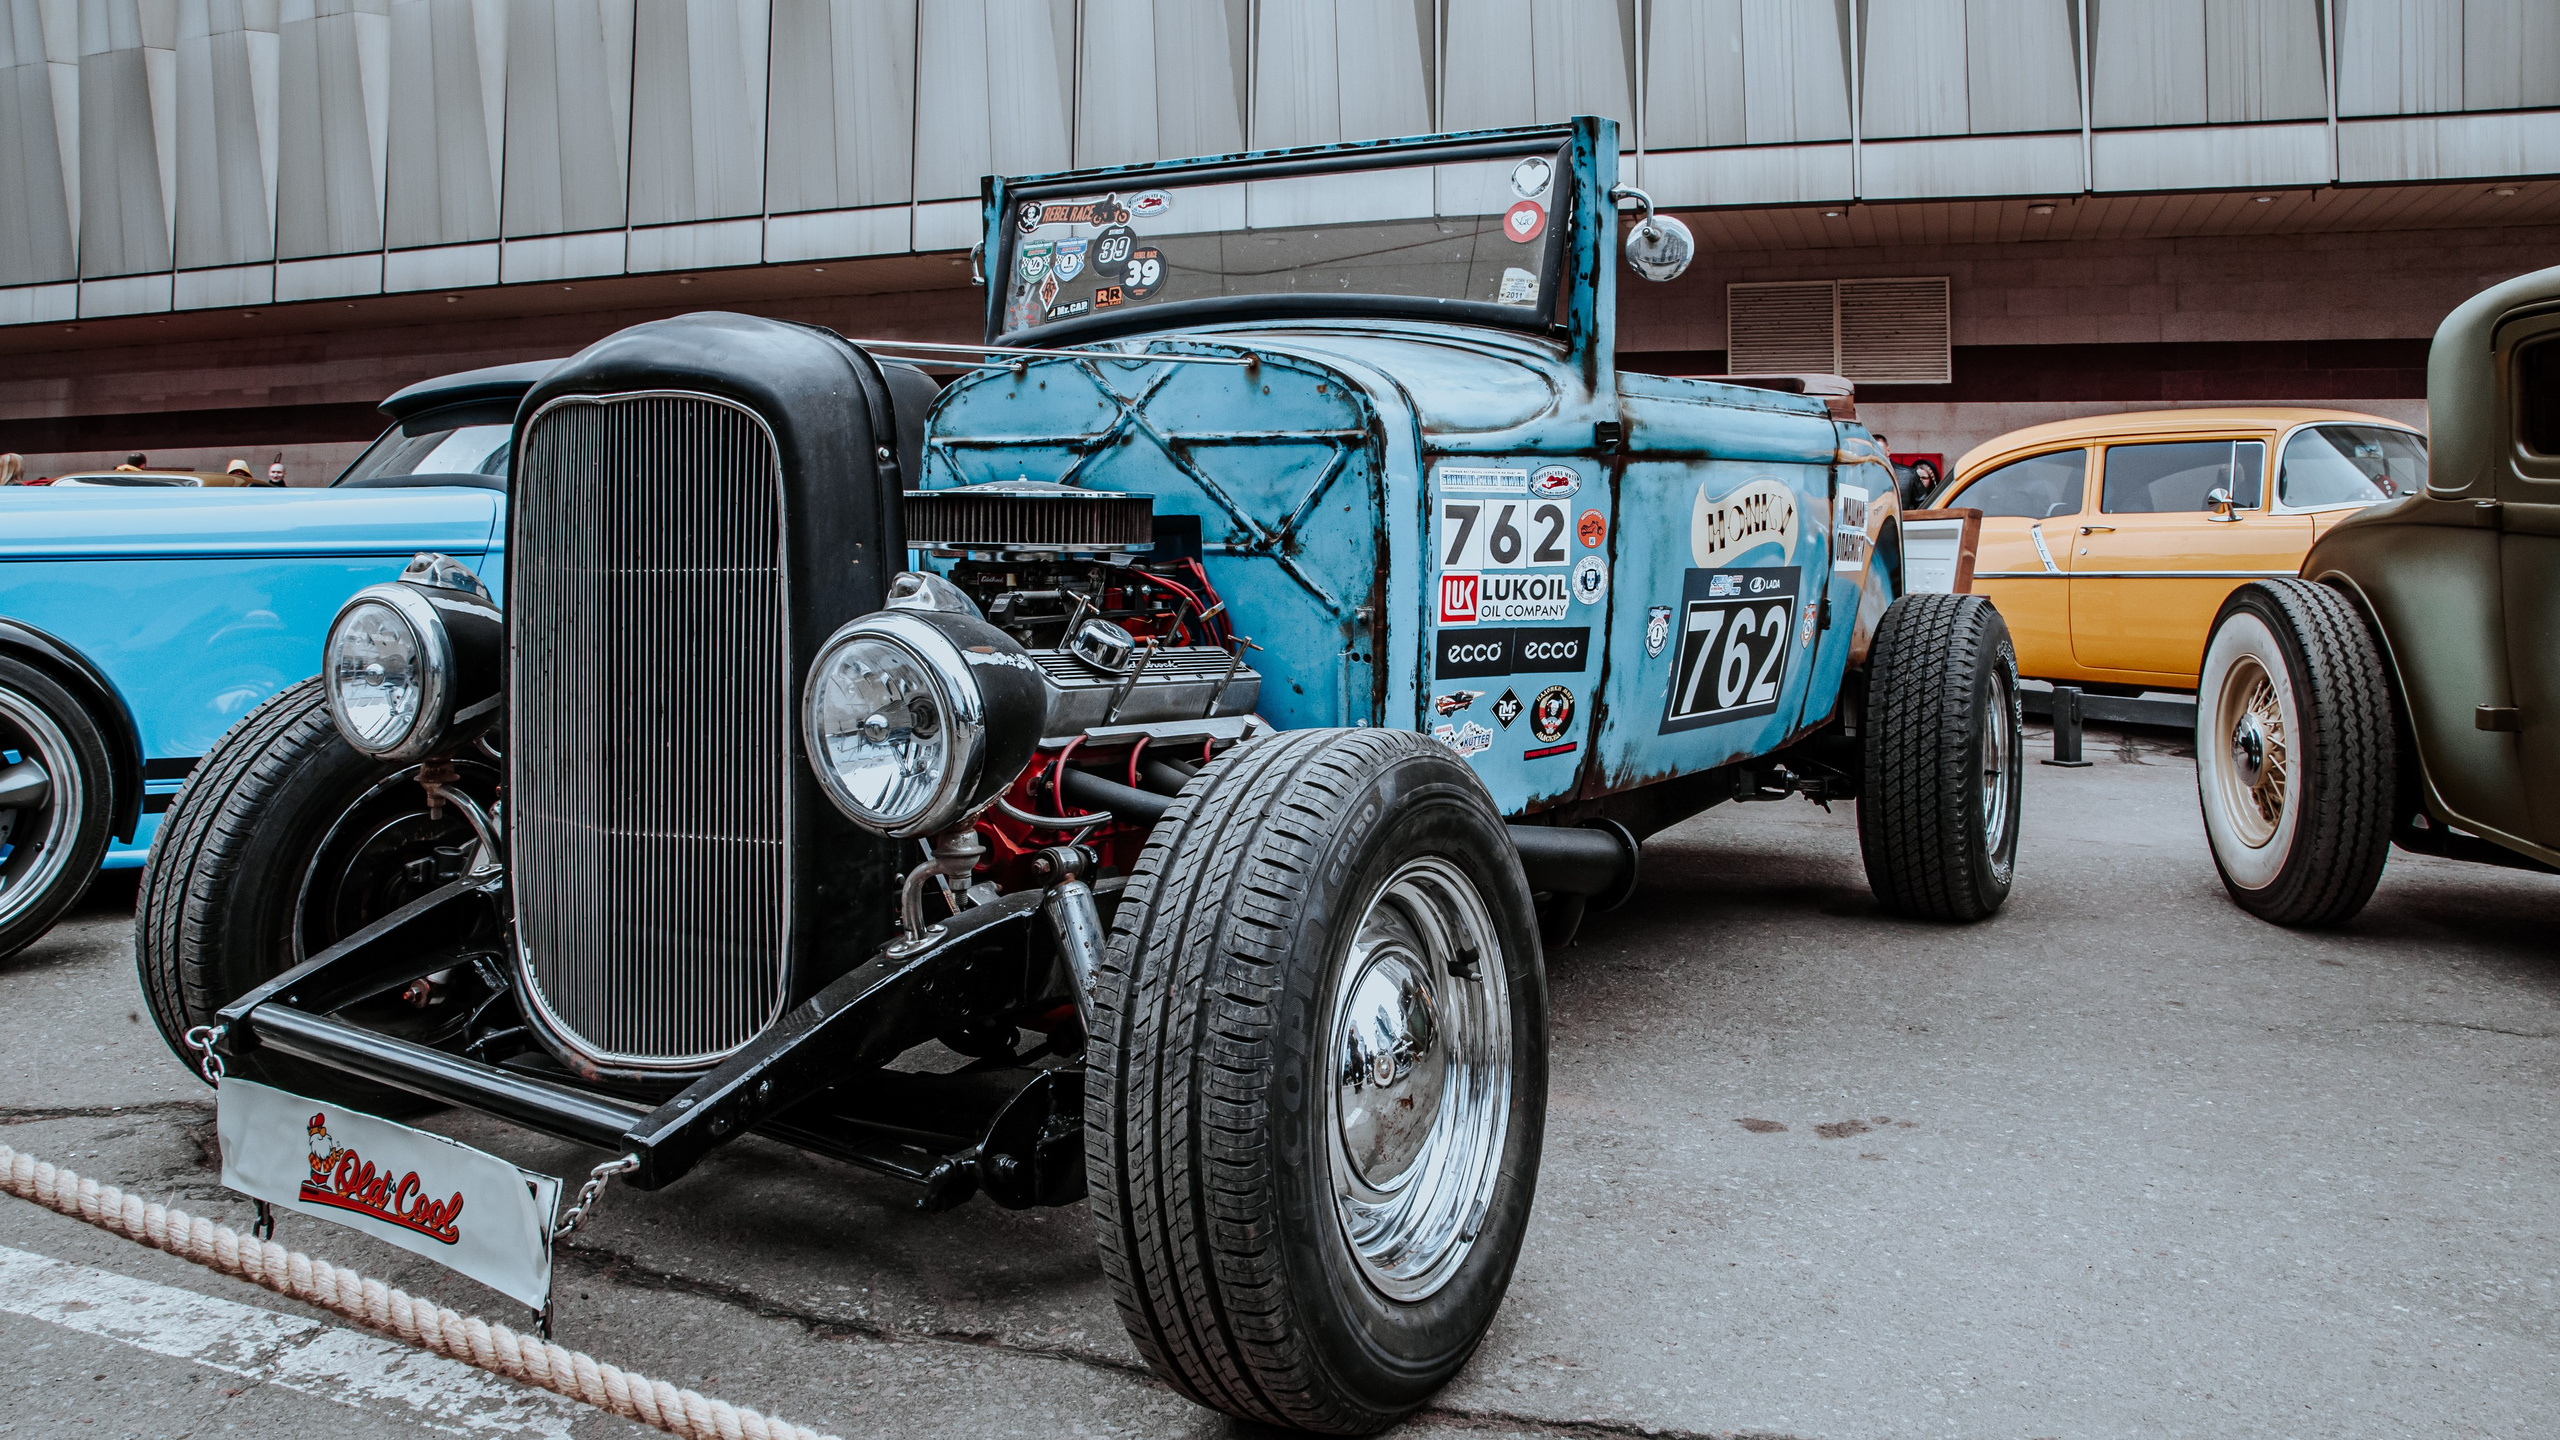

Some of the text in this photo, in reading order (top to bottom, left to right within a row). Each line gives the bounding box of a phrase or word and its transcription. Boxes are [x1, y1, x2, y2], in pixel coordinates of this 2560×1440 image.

[1042, 206, 1070, 222] REBEL
[1069, 204, 1096, 221] RACE
[1098, 236, 1131, 264] 39
[1133, 250, 1158, 259] REBEL RACE
[1125, 259, 1160, 287] 39
[1096, 288, 1121, 303] RR
[1505, 291, 1523, 299] 2011
[1057, 306, 1070, 316] Mr.
[1445, 504, 1565, 565] 762
[1707, 493, 1793, 554] HONKY
[1482, 579, 1566, 601] LUKOIL
[1765, 579, 1780, 589] LADA
[1481, 604, 1566, 618] OIL COMPANY
[1448, 641, 1502, 663] ecco
[1525, 640, 1579, 659] ecco
[1680, 605, 1787, 714] 762
[1463, 733, 1490, 747] KUTTER
[1328, 803, 1377, 888] EP150
[1280, 918, 1326, 1221] ECOPIA
[334, 1149, 464, 1237] Old is Cool
